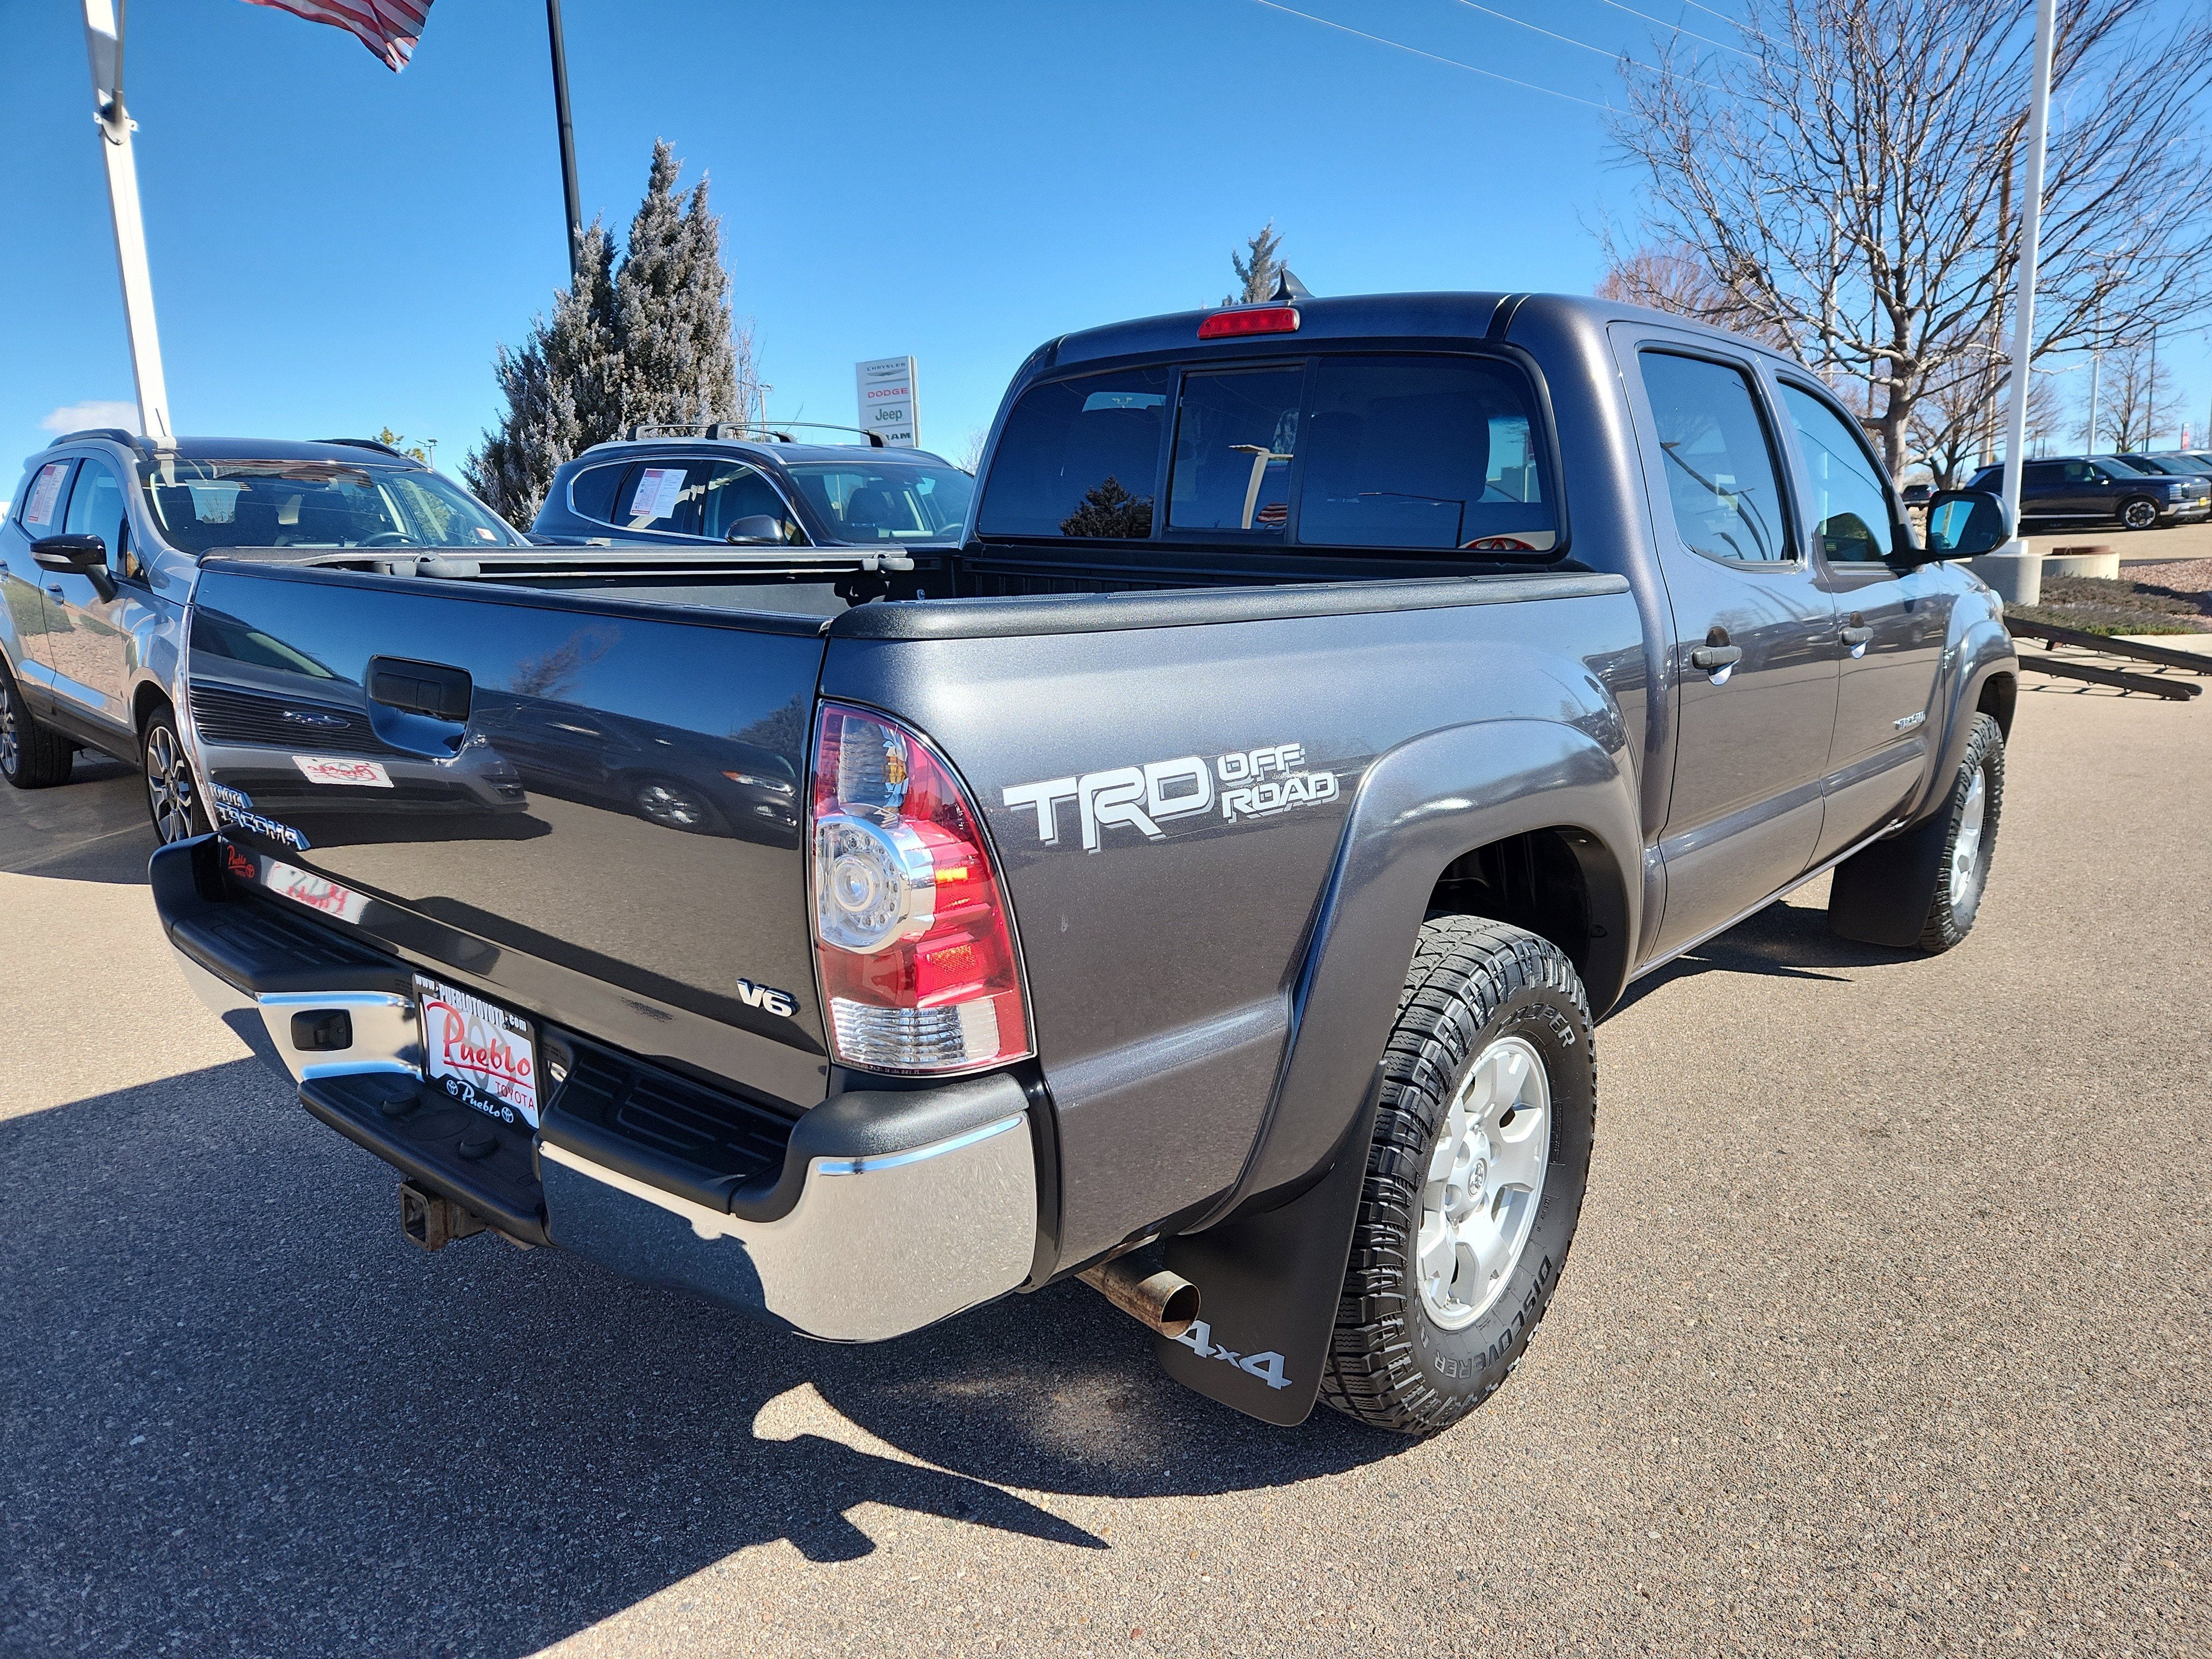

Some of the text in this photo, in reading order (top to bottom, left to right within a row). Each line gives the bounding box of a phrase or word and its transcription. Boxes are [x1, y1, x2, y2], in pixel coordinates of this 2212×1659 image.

[867, 363, 906, 371] CHRYSLER
[868, 388, 908, 398] DODGE
[875, 408, 903, 422] Jeep
[1218, 742, 1305, 787] OFF
[1002, 755, 1215, 854] TRD
[1221, 771, 1339, 823] ROAD
[215, 801, 311, 850] TACOMA
[415, 974, 528, 1032] www.PUEBLOTOYOTA.com
[736, 978, 796, 1017] V6
[427, 1001, 531, 1076] Pueblo
[1493, 1002, 1575, 1049] COOPER
[457, 1081, 499, 1117] Pueblo
[496, 1081, 535, 1111] TOYOTA
[1434, 1255, 1552, 1379] DISCOVERER
[1175, 1320, 1293, 1390] 4x4
